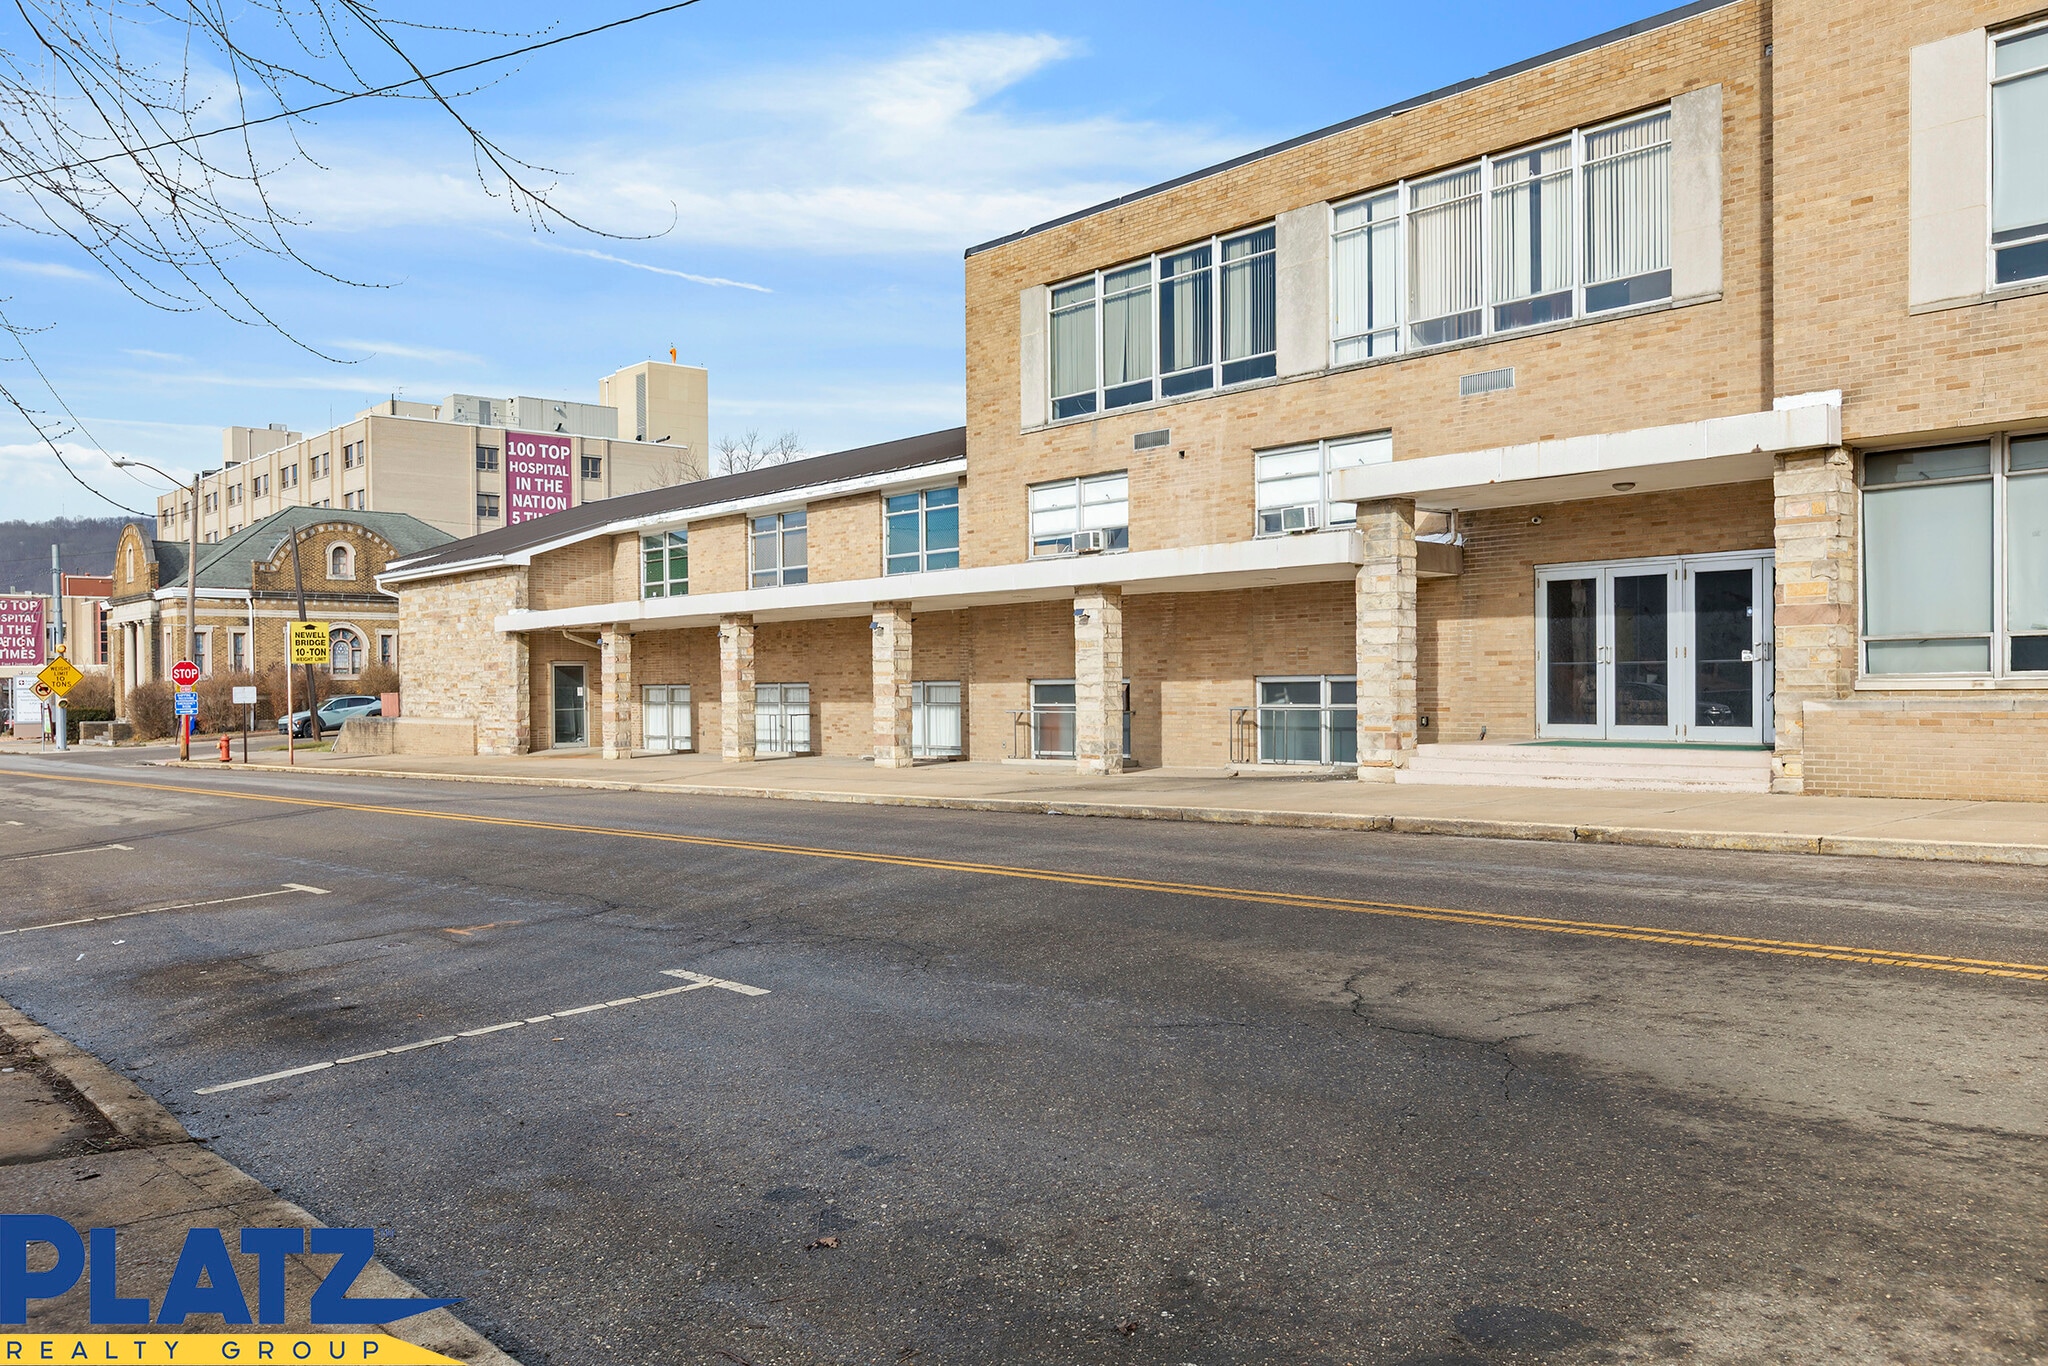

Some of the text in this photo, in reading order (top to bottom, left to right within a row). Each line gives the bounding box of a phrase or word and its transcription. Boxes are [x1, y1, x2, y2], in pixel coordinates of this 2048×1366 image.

[508, 441, 571, 460] 100 TOP
[509, 460, 569, 477] HOSPITAL
[515, 476, 564, 493] IN THE
[512, 493, 567, 511] NATION
[511, 511, 521, 525] 5
[10, 600, 38, 611] TOP
[6, 625, 32, 635] THE
[295, 647, 327, 656] 10-TON
[173, 668, 198, 679] STOP
